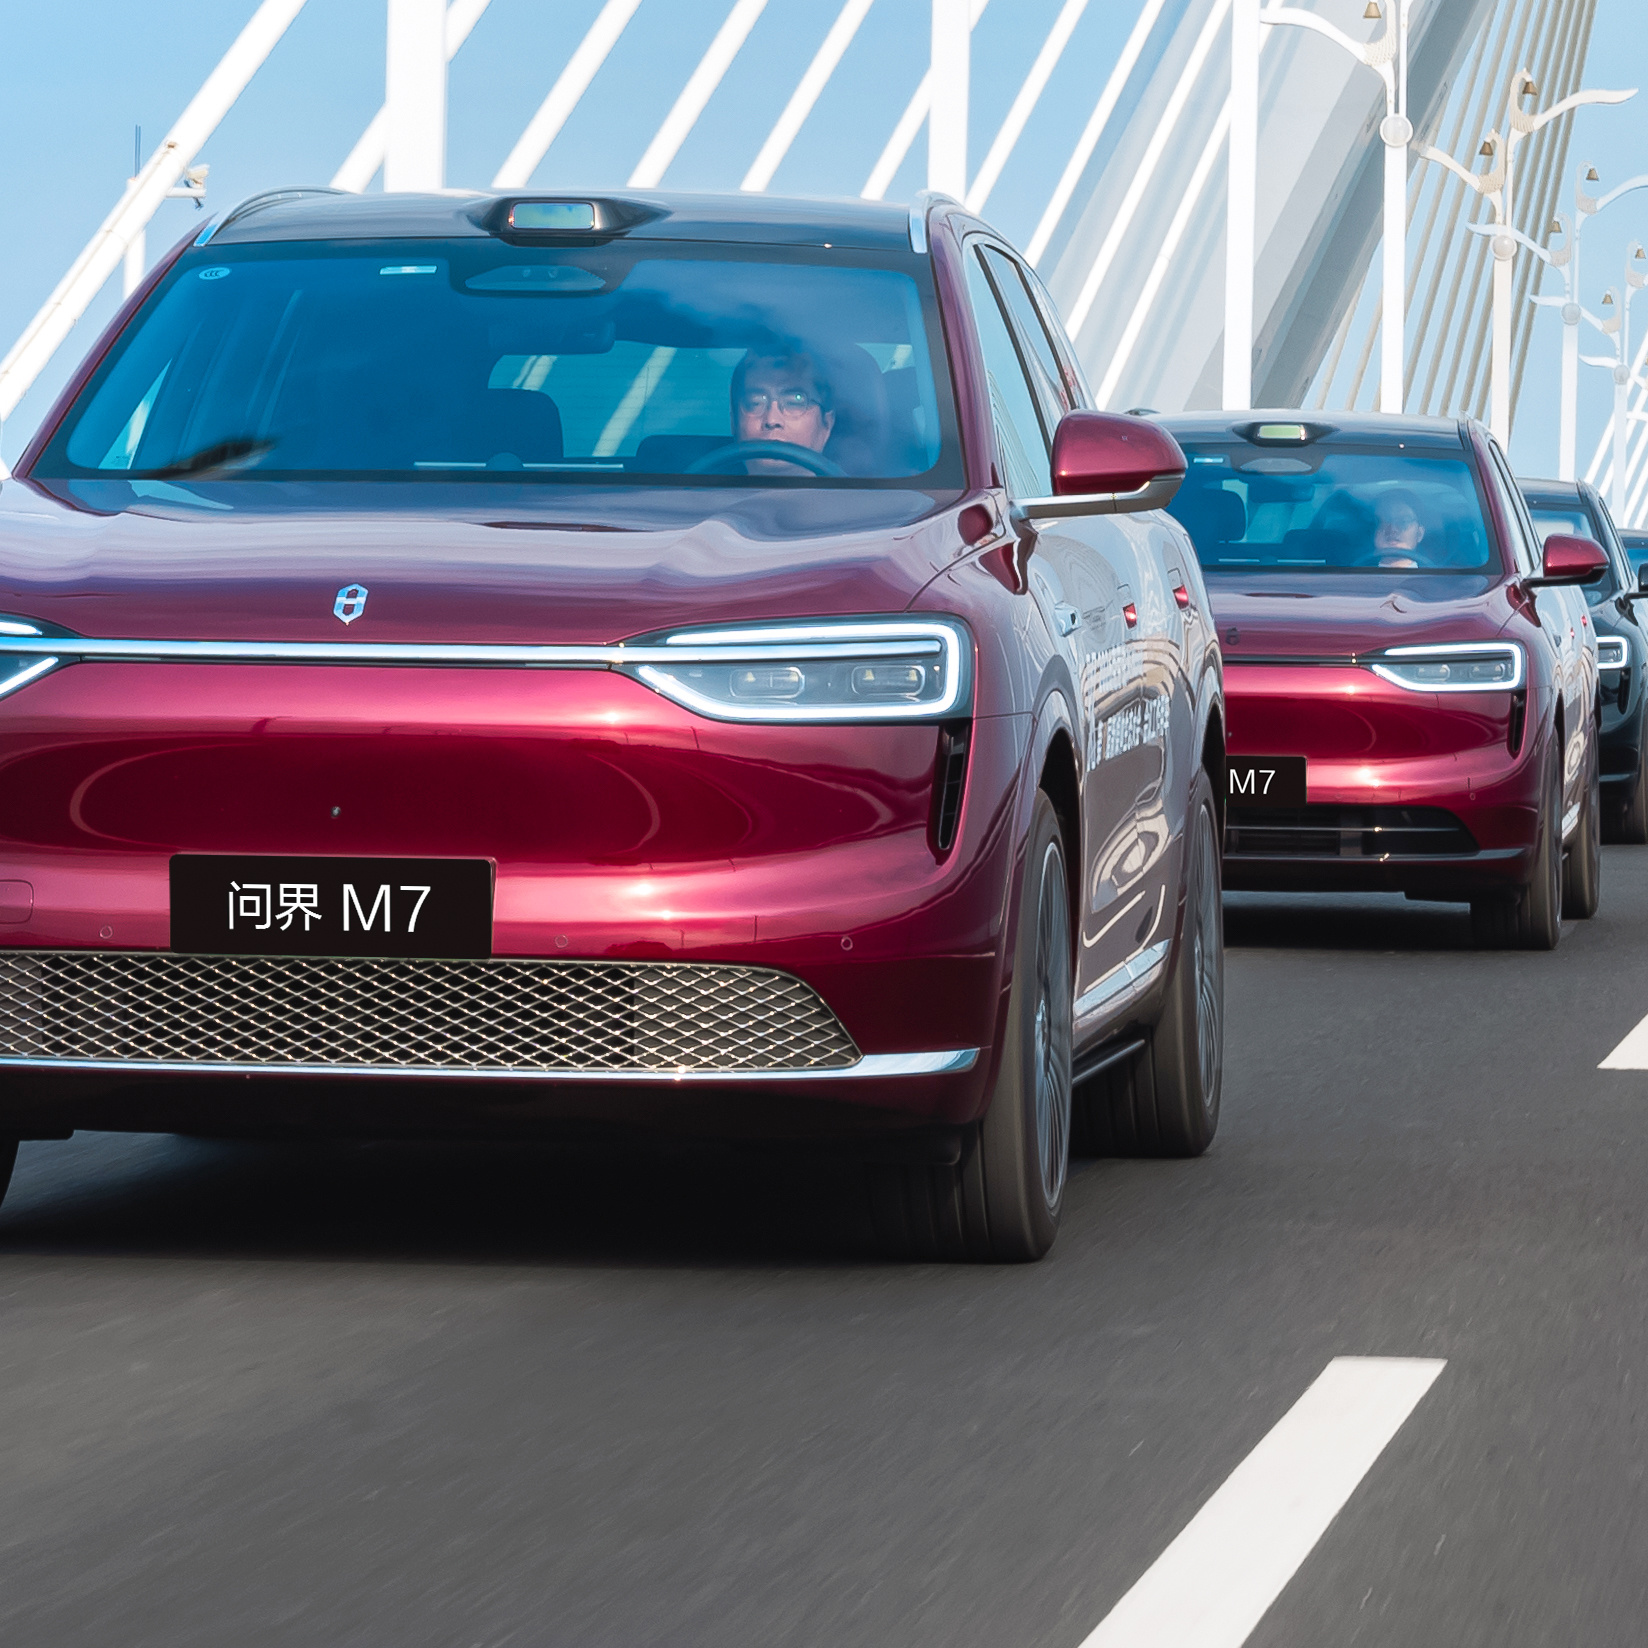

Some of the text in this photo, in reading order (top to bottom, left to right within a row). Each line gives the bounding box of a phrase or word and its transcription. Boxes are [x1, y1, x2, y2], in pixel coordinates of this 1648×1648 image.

[1229, 768, 1276, 795] M7
[227, 880, 432, 933] 问界 M7
